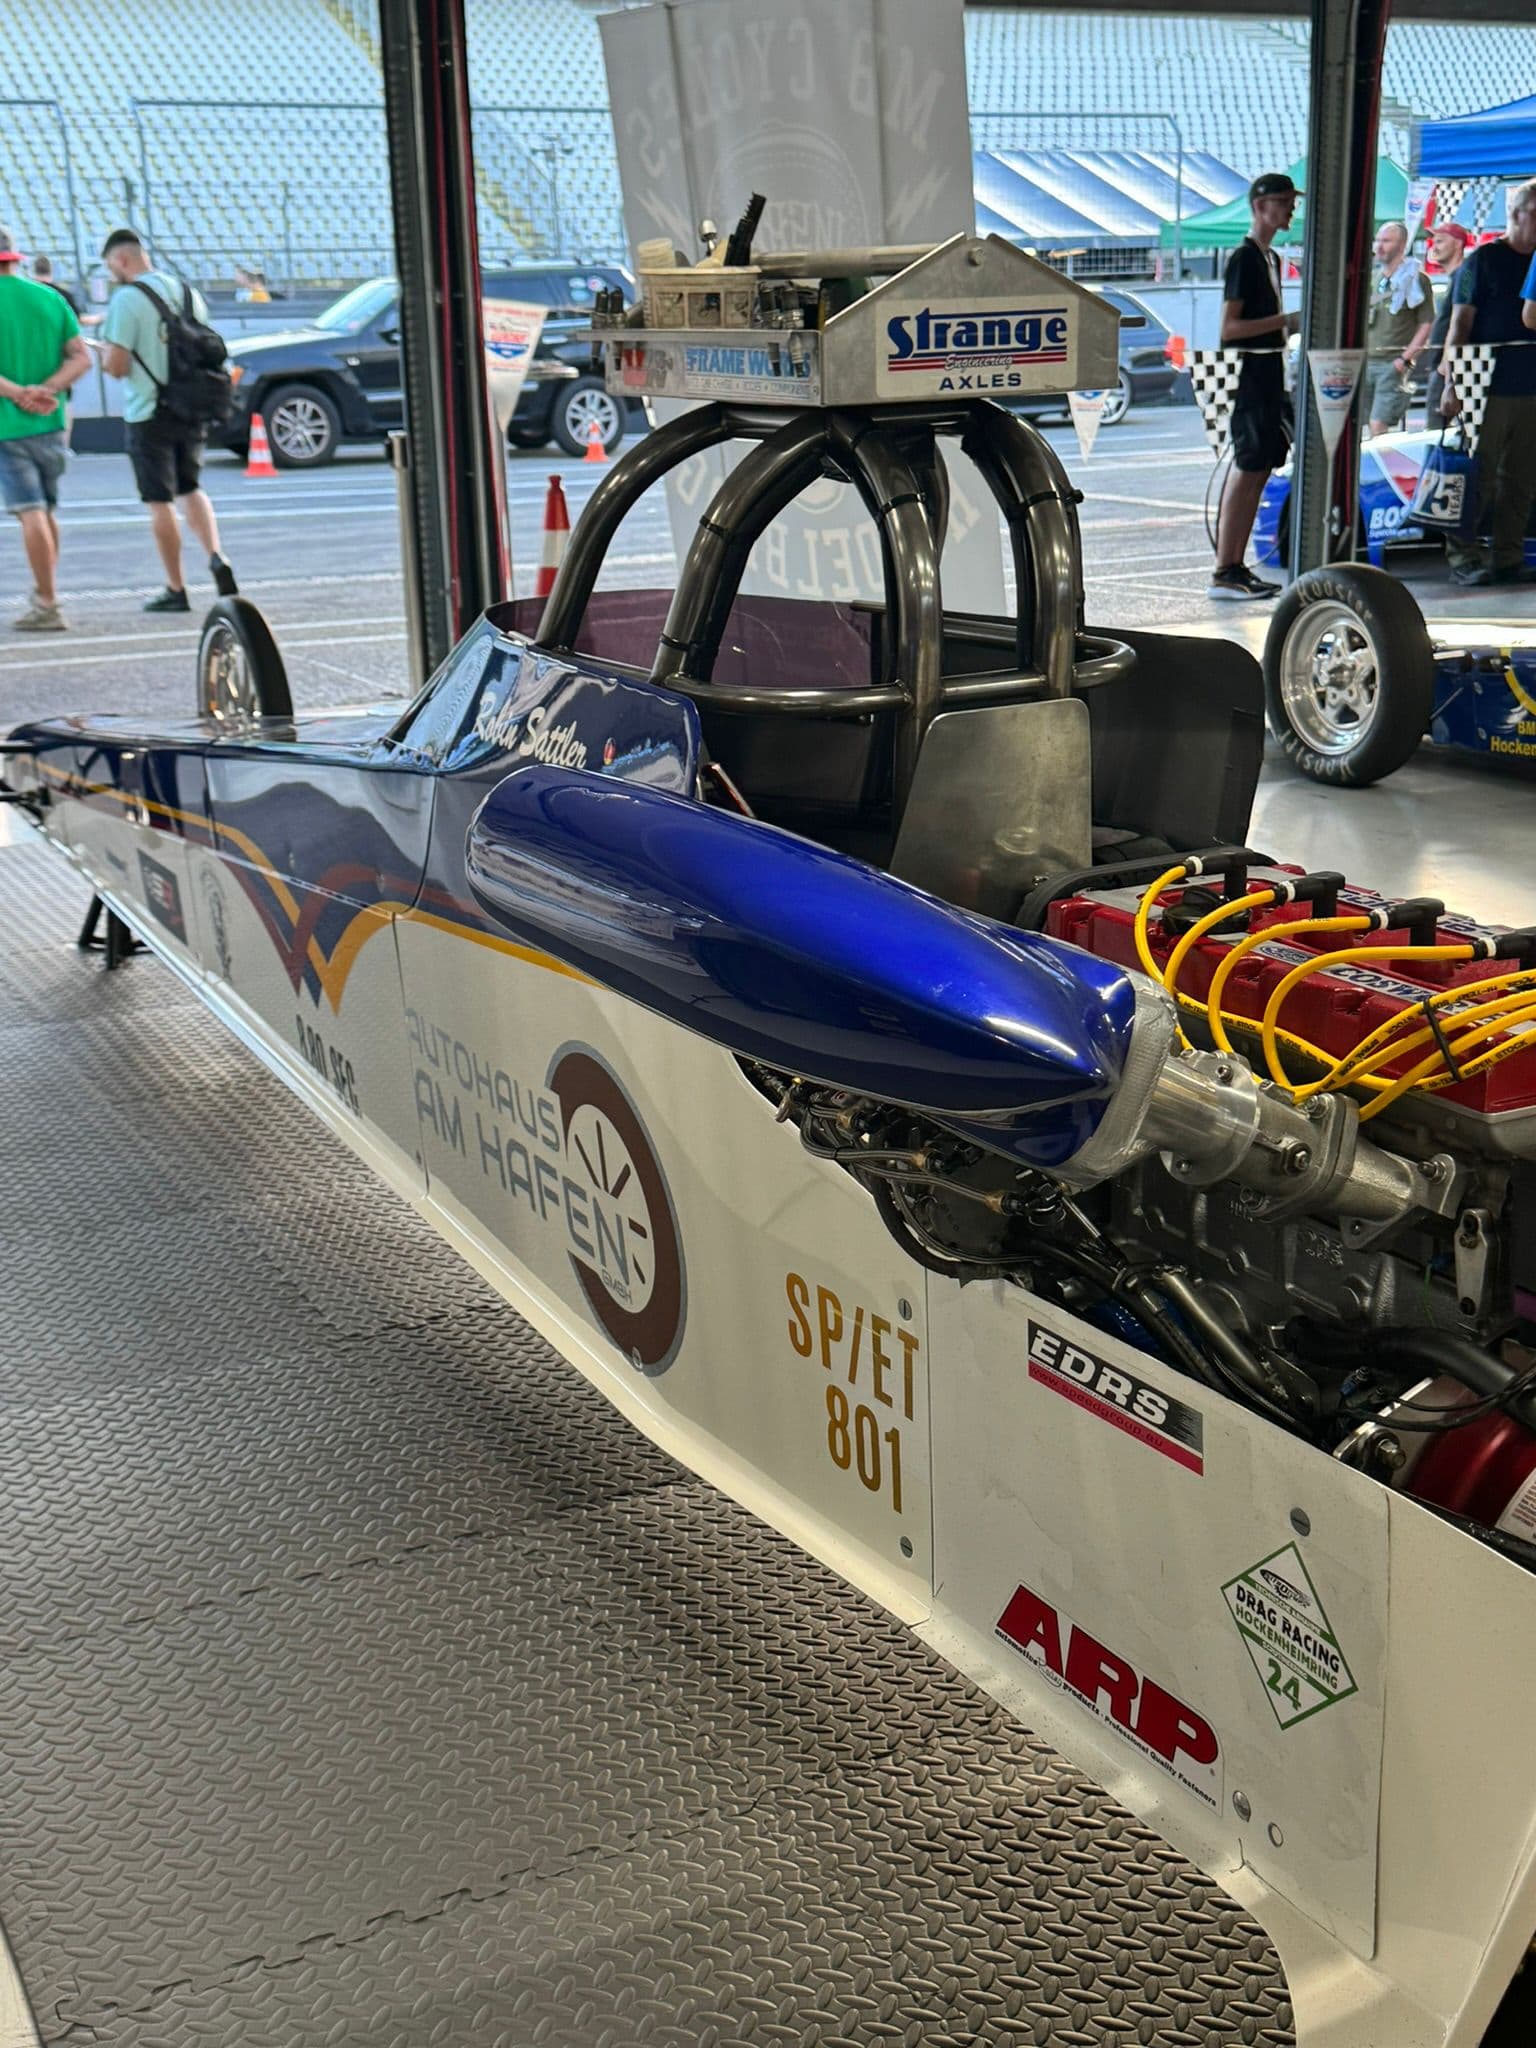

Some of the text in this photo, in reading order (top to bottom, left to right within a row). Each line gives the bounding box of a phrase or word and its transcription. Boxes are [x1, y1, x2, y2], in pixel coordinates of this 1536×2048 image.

[887, 307, 1068, 359] Strange
[944, 354, 1014, 372] Engineering
[939, 373, 1022, 391] AXLES
[474, 691, 588, 769] Robin Sattler
[405, 1008, 561, 1153] AUTOHAUS
[415, 1067, 466, 1158] AM
[476, 1112, 630, 1286] HAFEN
[786, 1272, 920, 1422] SP/ET
[1030, 1329, 1170, 1426] EDRS
[826, 1384, 903, 1515] 801
[996, 1583, 1219, 1765] ARP
[1235, 1603, 1339, 1690] HOCKENHEIMRING
[1236, 1584, 1277, 1627] DRAG
[1281, 1615, 1341, 1674] RACING
[1266, 1657, 1302, 1712] 24
[1104, 1716, 1150, 1754] Professional
[1150, 1751, 1177, 1776] Quality
[1178, 1772, 1217, 1807] Fasteners
